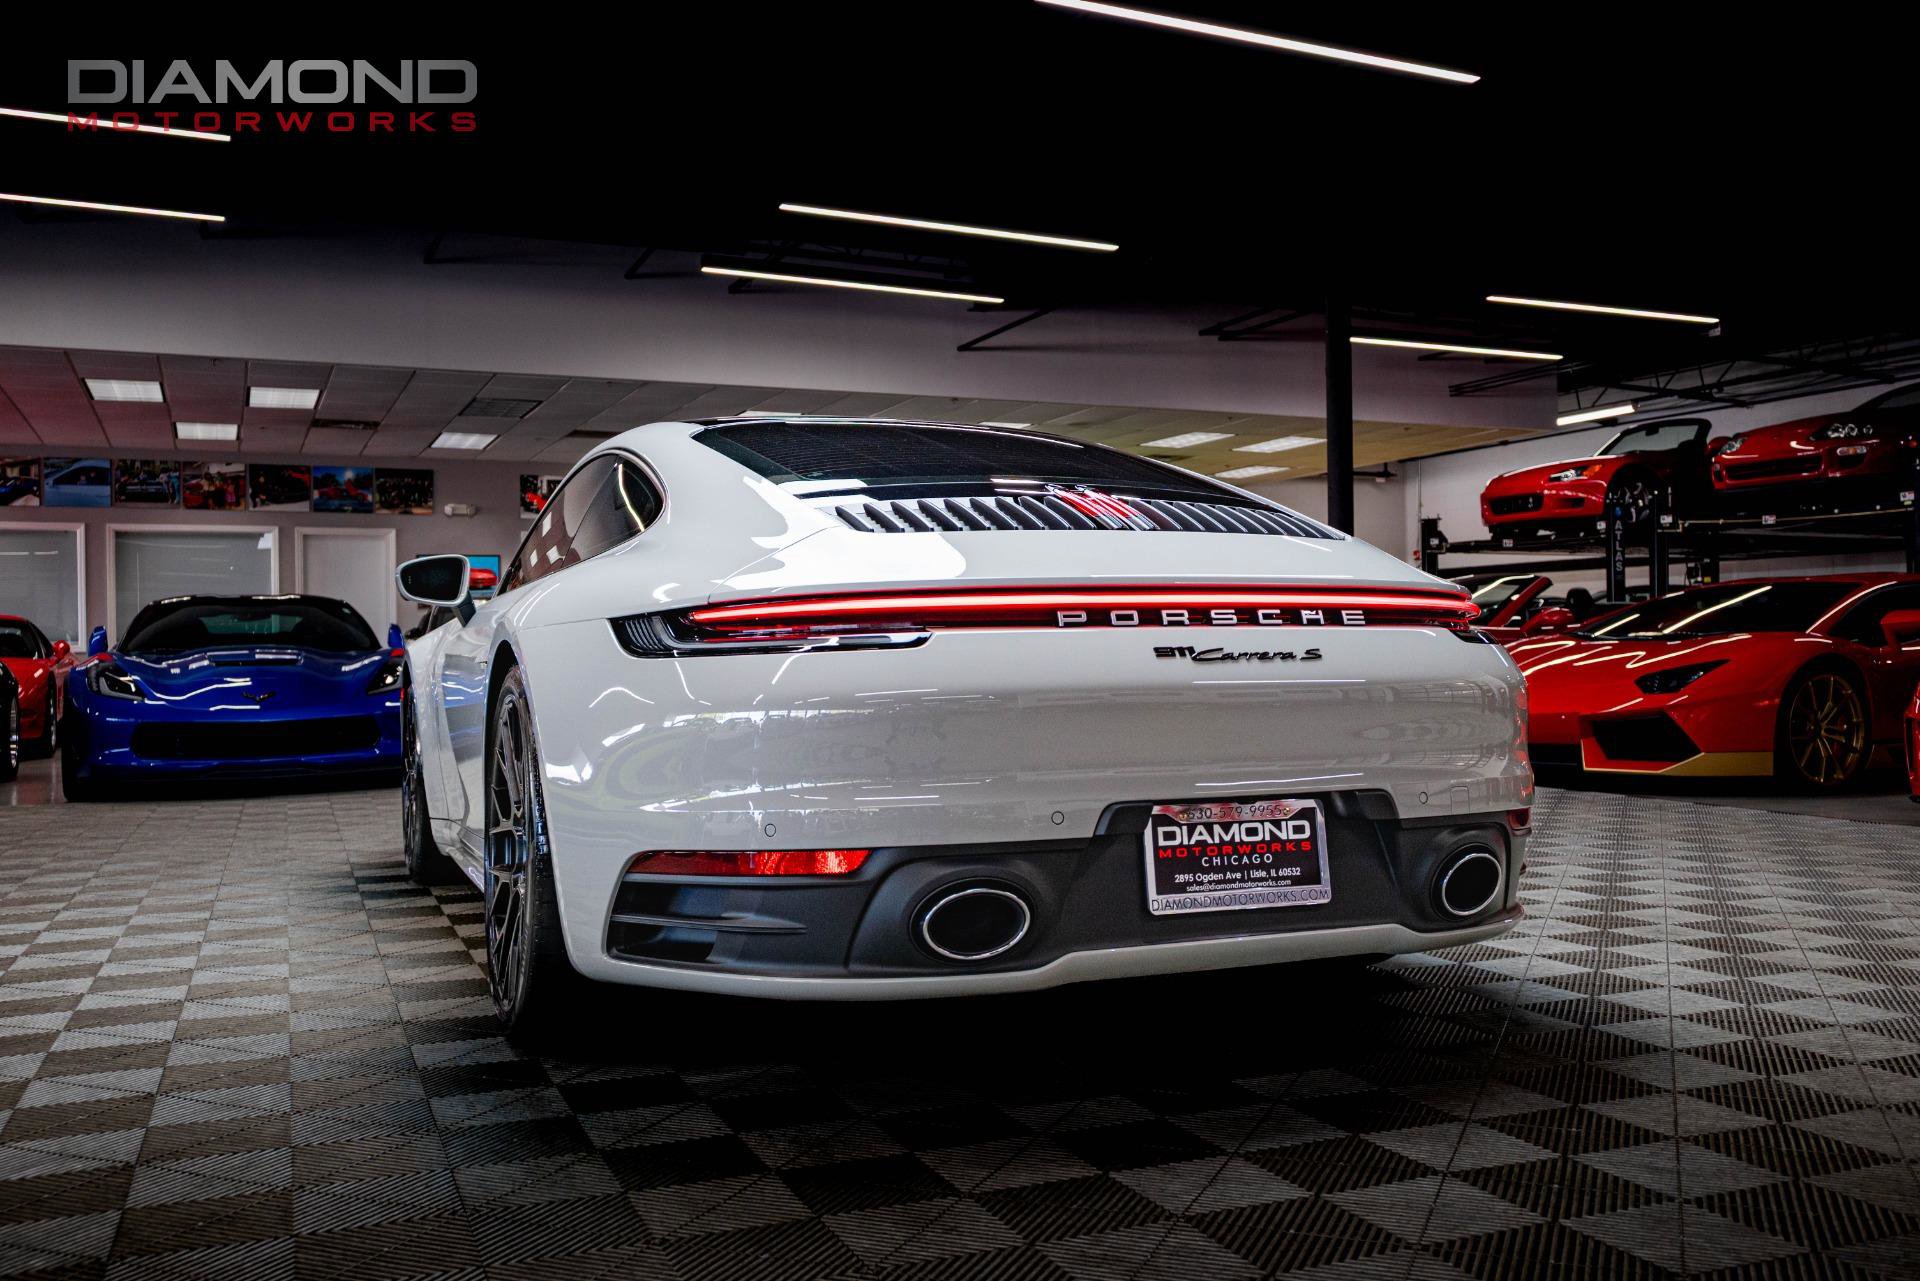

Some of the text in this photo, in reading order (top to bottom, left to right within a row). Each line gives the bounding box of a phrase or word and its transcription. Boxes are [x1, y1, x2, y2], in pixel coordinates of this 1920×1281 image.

[1614, 520, 1623, 572] ATLAS
[1056, 609, 1366, 626] PORSCHE
[1153, 645, 1323, 662] 911 Carrera S
[1157, 820, 1311, 847] DIAMOND
[1159, 841, 1312, 859] MOTORWORKS
[1201, 853, 1273, 867] CHICAGO
[1174, 873, 1194, 883] 2895
[1195, 872, 1224, 883] Ogden
[1225, 871, 1242, 880] Ave
[1250, 869, 1269, 878] Lisle,
[1270, 868, 1277, 877] IL
[1278, 867, 1301, 877] 60532
[1186, 879, 1291, 892] sales@diamondmotorworks.com
[1151, 888, 1330, 911] DIAMONDMOTORWORKS.COM
